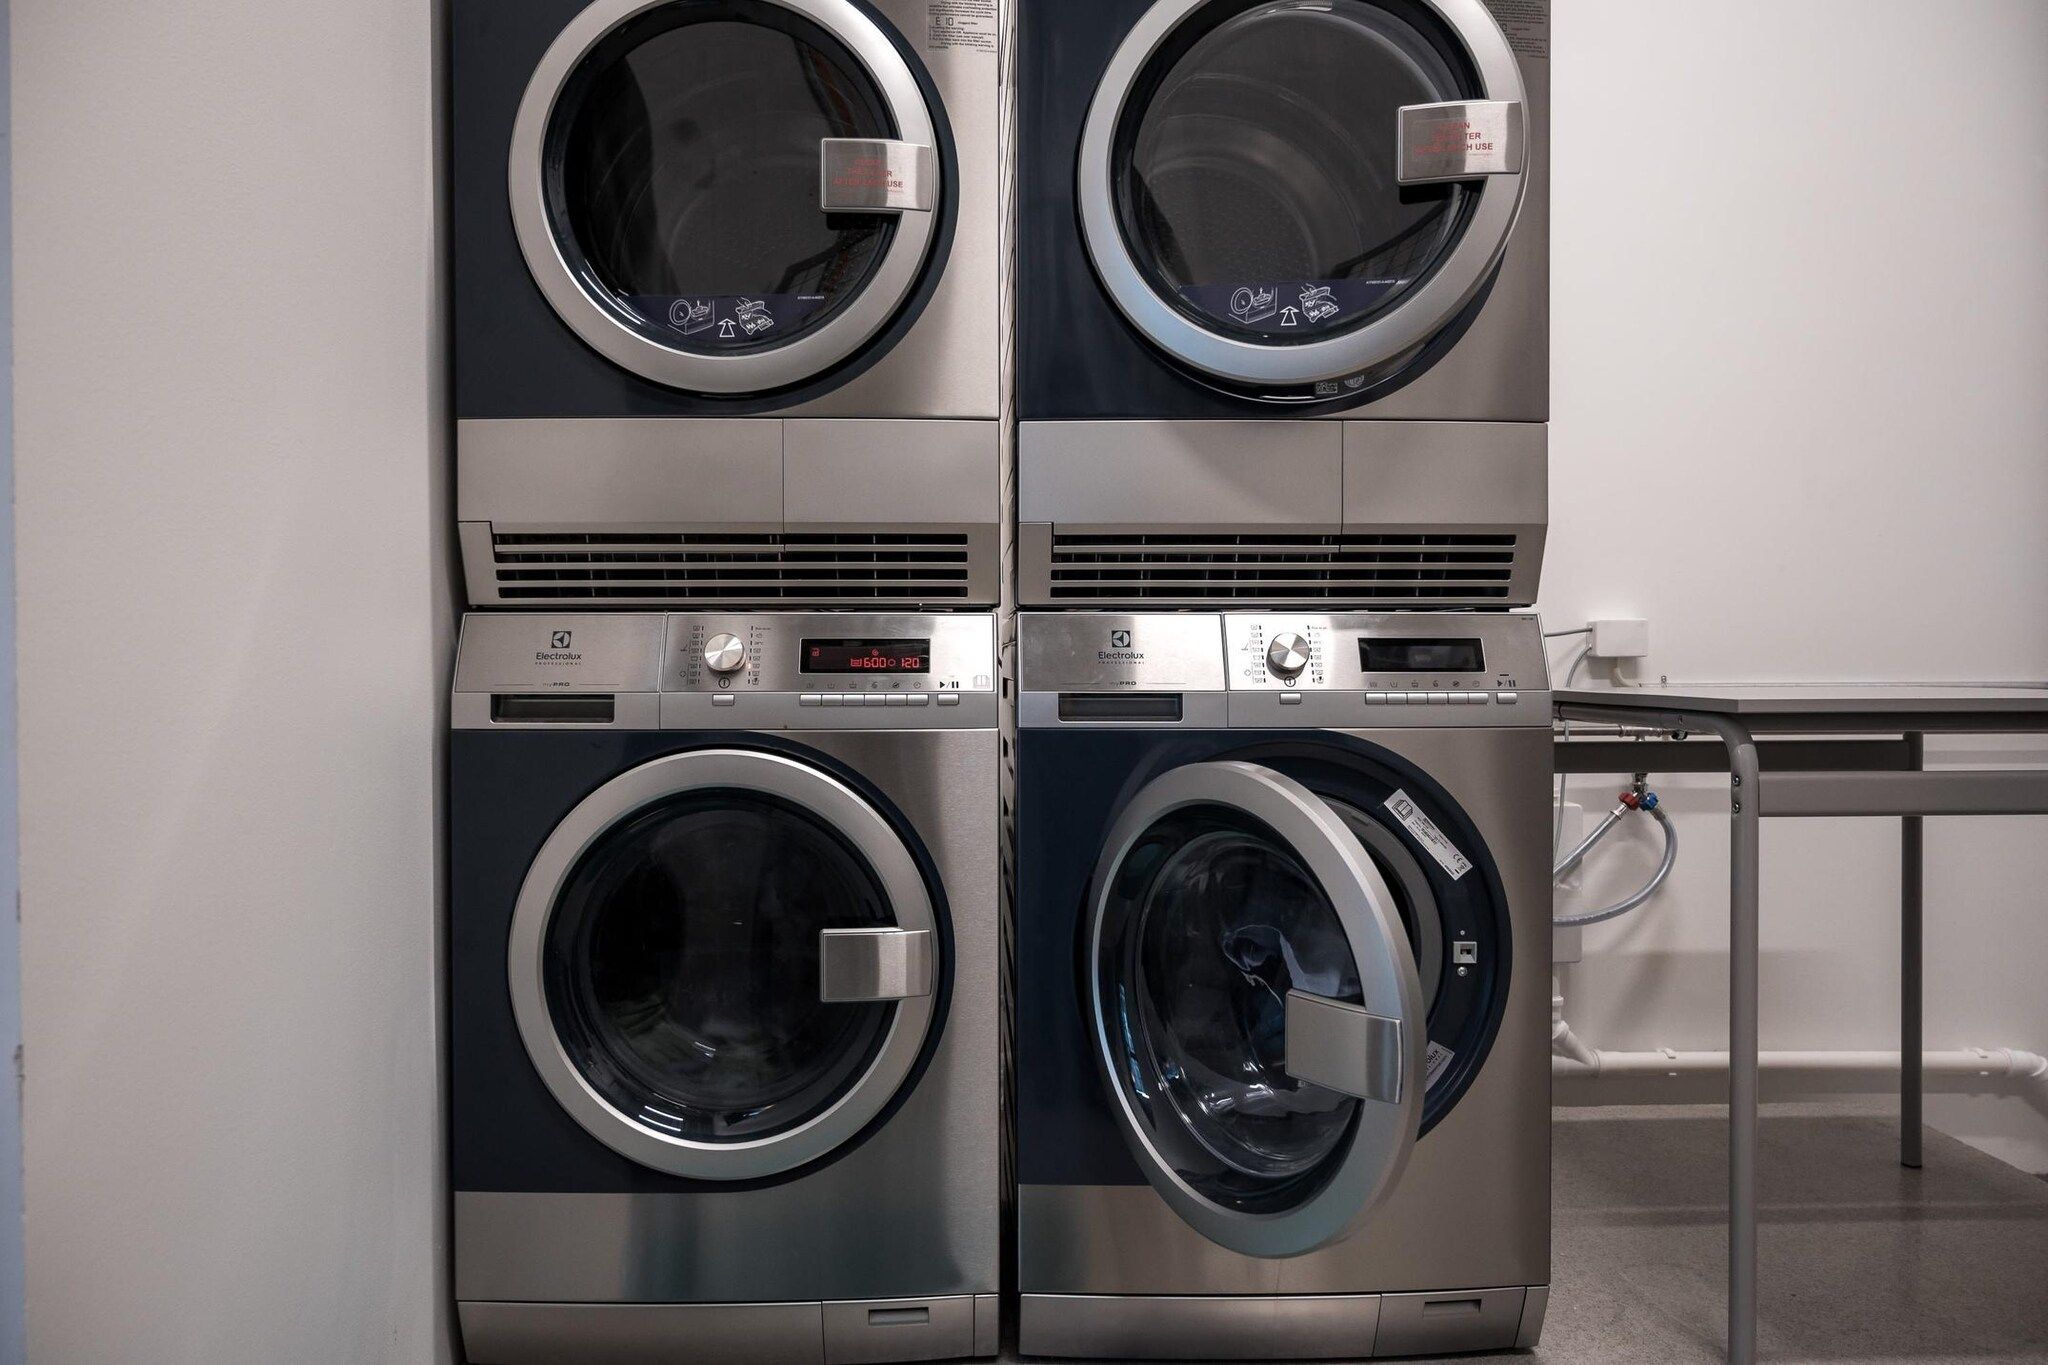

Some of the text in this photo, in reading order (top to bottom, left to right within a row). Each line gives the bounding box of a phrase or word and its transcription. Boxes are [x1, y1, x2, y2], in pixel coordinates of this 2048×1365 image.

[936, 17, 940, 26] E
[1475, 142, 1493, 150] USE
[887, 180, 903, 188] USE
[536, 652, 582, 660] Electrolux
[864, 658, 920, 668] 600 120
